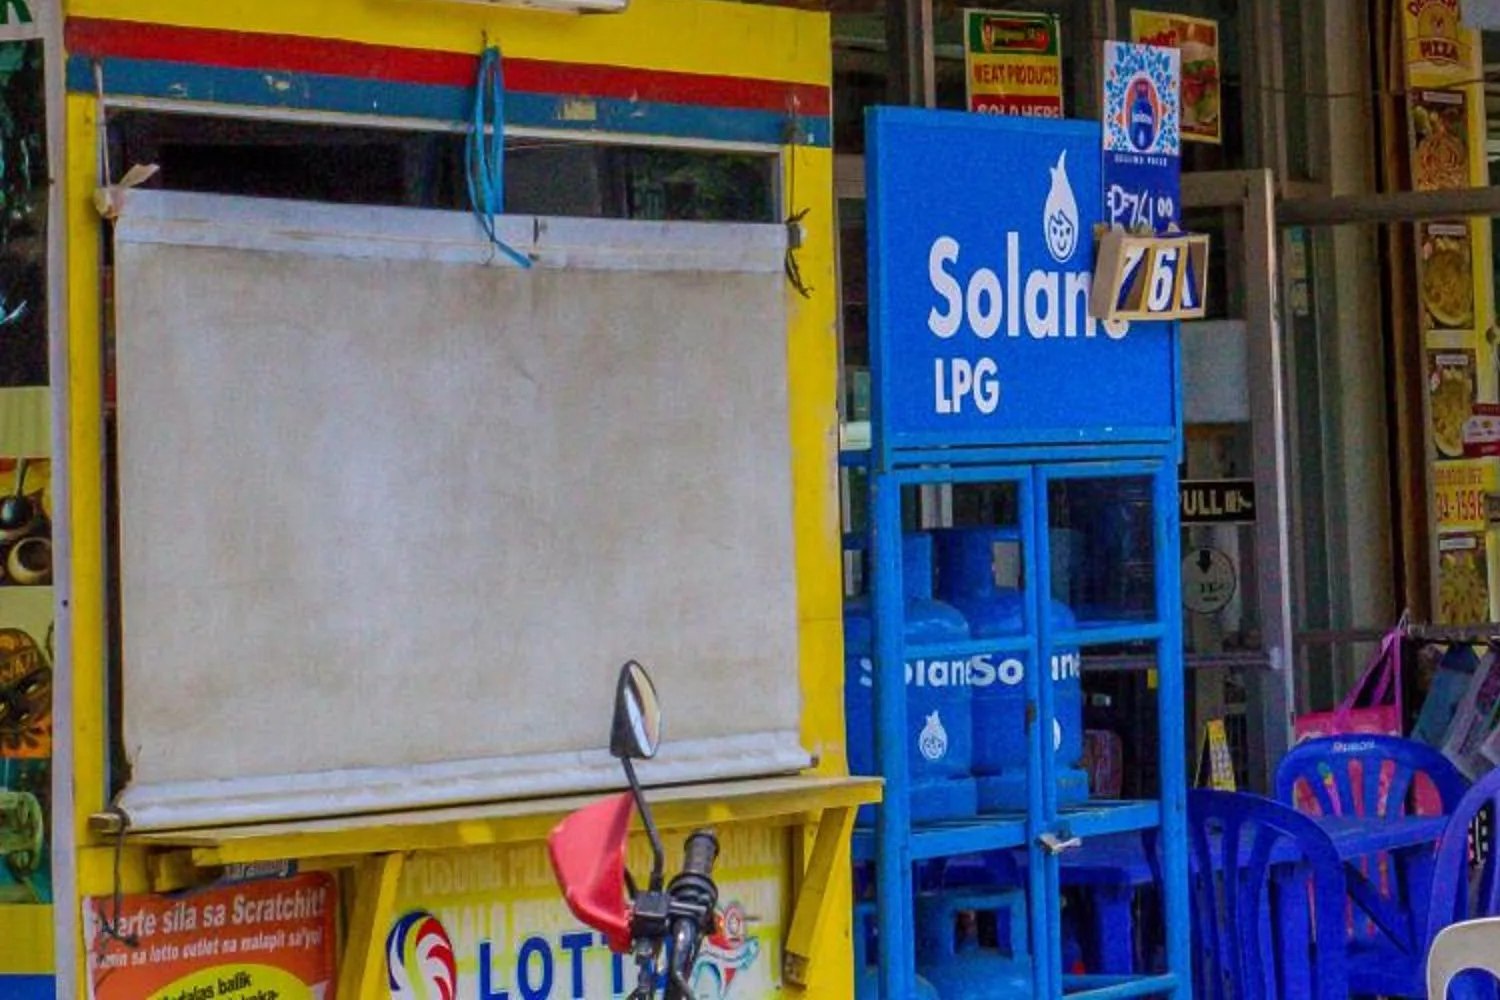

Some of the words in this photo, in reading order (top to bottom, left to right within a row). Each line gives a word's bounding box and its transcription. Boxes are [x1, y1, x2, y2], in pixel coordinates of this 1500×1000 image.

[974, 63, 1006, 85] MEAT
[1009, 64, 1058, 87] PRODUCTS
[934, 357, 999, 414] LPG
[1181, 489, 1223, 516] ULL
[163, 901, 197, 933] sila
[203, 905, 225, 929] sa
[232, 887, 326, 926] Scratchit!
[150, 945, 179, 963] lotto
[183, 939, 219, 959] outlet
[241, 931, 285, 953] malapit
[218, 970, 252, 995] balik
